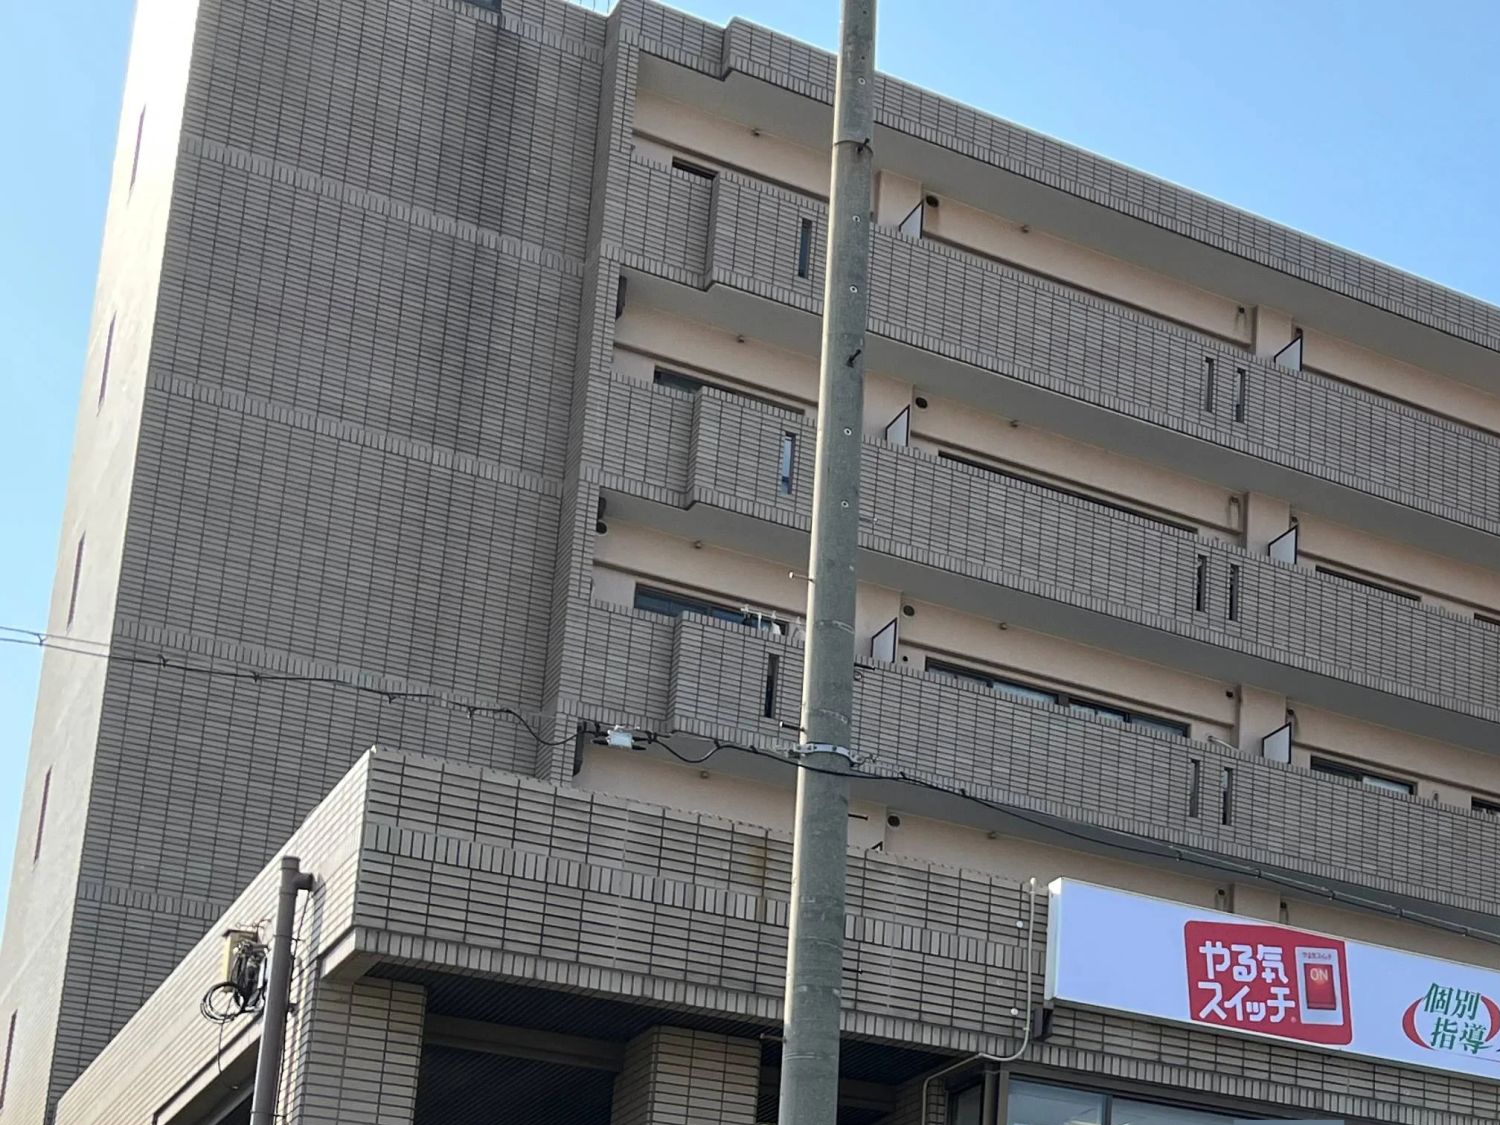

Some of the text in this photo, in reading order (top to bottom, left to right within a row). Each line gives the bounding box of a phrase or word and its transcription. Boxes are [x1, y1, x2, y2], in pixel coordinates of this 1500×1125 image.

[1199, 940, 1289, 984] やる気
[1310, 968, 1328, 981] ON
[1198, 981, 1295, 1022] スイッチ
[1423, 983, 1480, 1020] 個別
[1430, 1017, 1488, 1054] 指導
